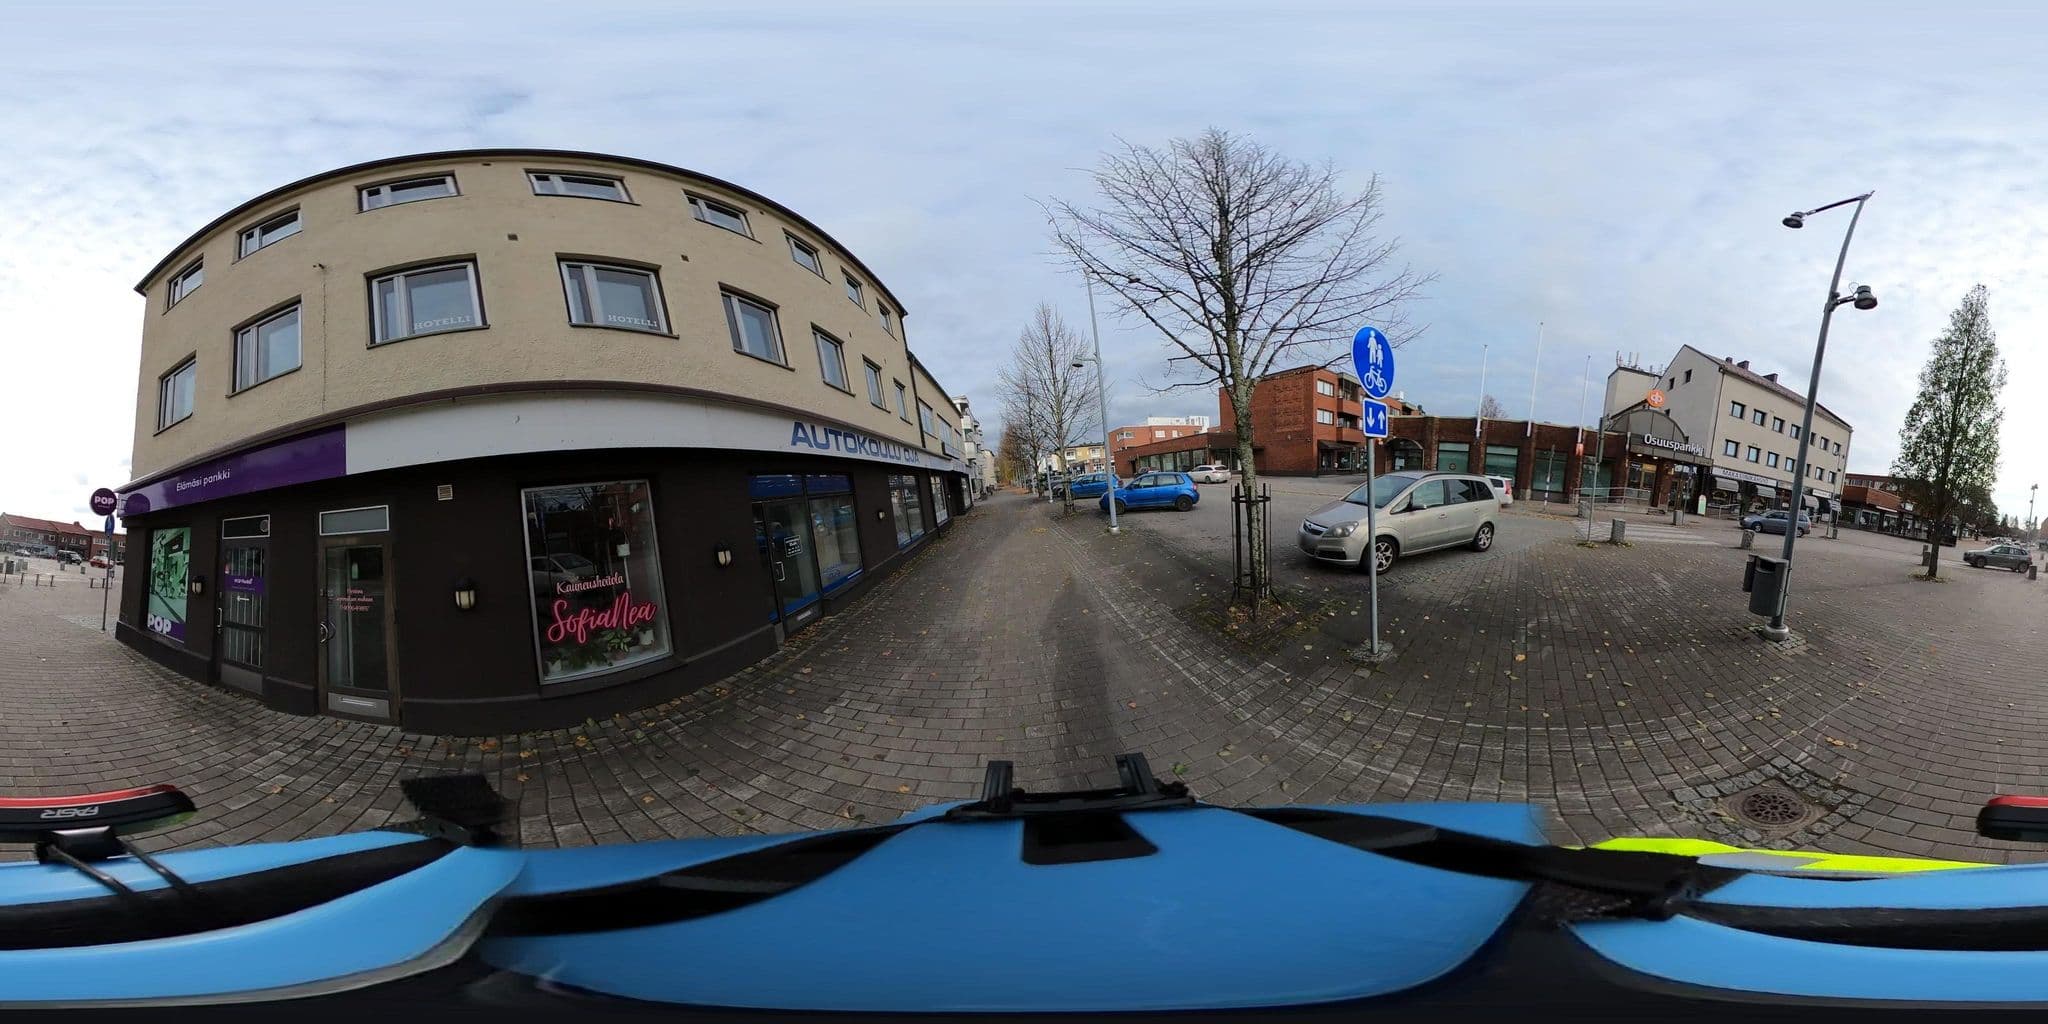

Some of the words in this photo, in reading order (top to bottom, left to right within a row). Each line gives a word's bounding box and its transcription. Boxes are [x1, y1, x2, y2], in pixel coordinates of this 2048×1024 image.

[414, 315, 472, 330] HOTELLI
[608, 314, 658, 328] HOTELLI
[790, 421, 901, 460] AUTOKOULU
[904, 447, 920, 464] OJA
[1644, 433, 1705, 457] Osuuspankki
[176, 479, 203, 492] Elämäsi
[203, 468, 231, 487] pankki
[94, 495, 115, 505] POP
[556, 571, 625, 595] Kauneushoitola
[147, 612, 172, 634] POP
[547, 592, 657, 644] SofiaNea
